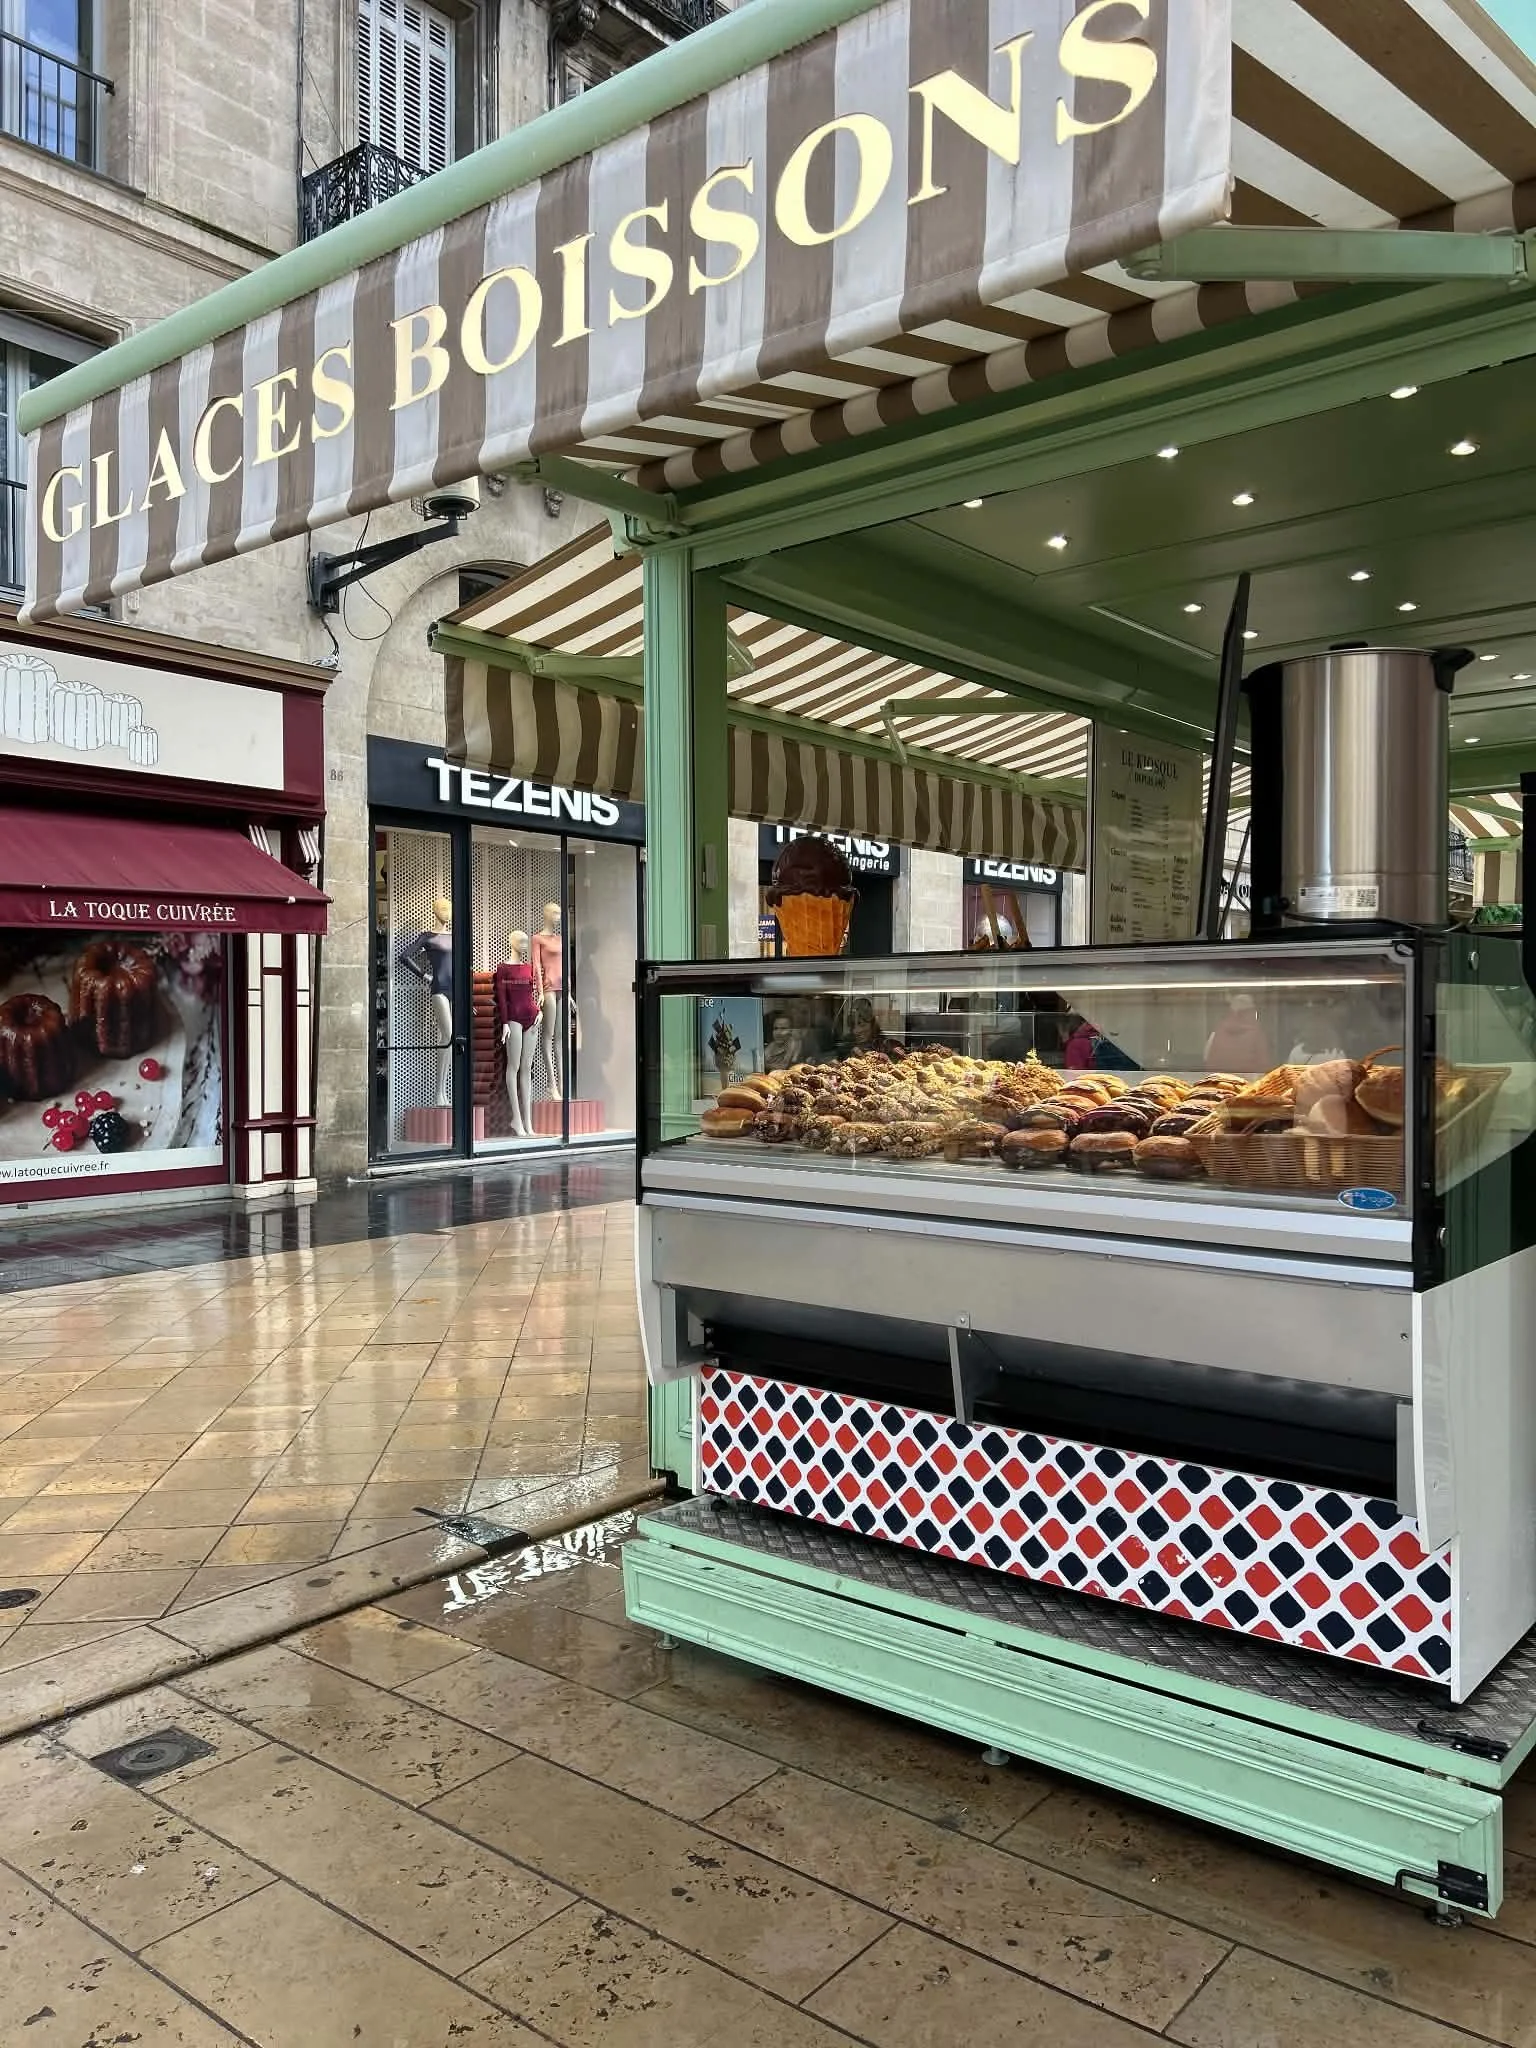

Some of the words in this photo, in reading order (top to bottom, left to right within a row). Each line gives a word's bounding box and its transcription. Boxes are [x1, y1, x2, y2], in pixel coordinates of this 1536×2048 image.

[42, 341, 354, 543] GLACES
[387, 0, 1159, 412] BOISSONS
[427, 757, 620, 826] TEZENIS
[776, 825, 890, 858] TENIS
[973, 858, 1057, 885] TEZENIS
[50, 901, 78, 917] LA
[84, 902, 150, 920] TOQUE
[157, 903, 237, 922] CUIVRÉE
[0, 1161, 109, 1178] w.latoquecuivree.fr
